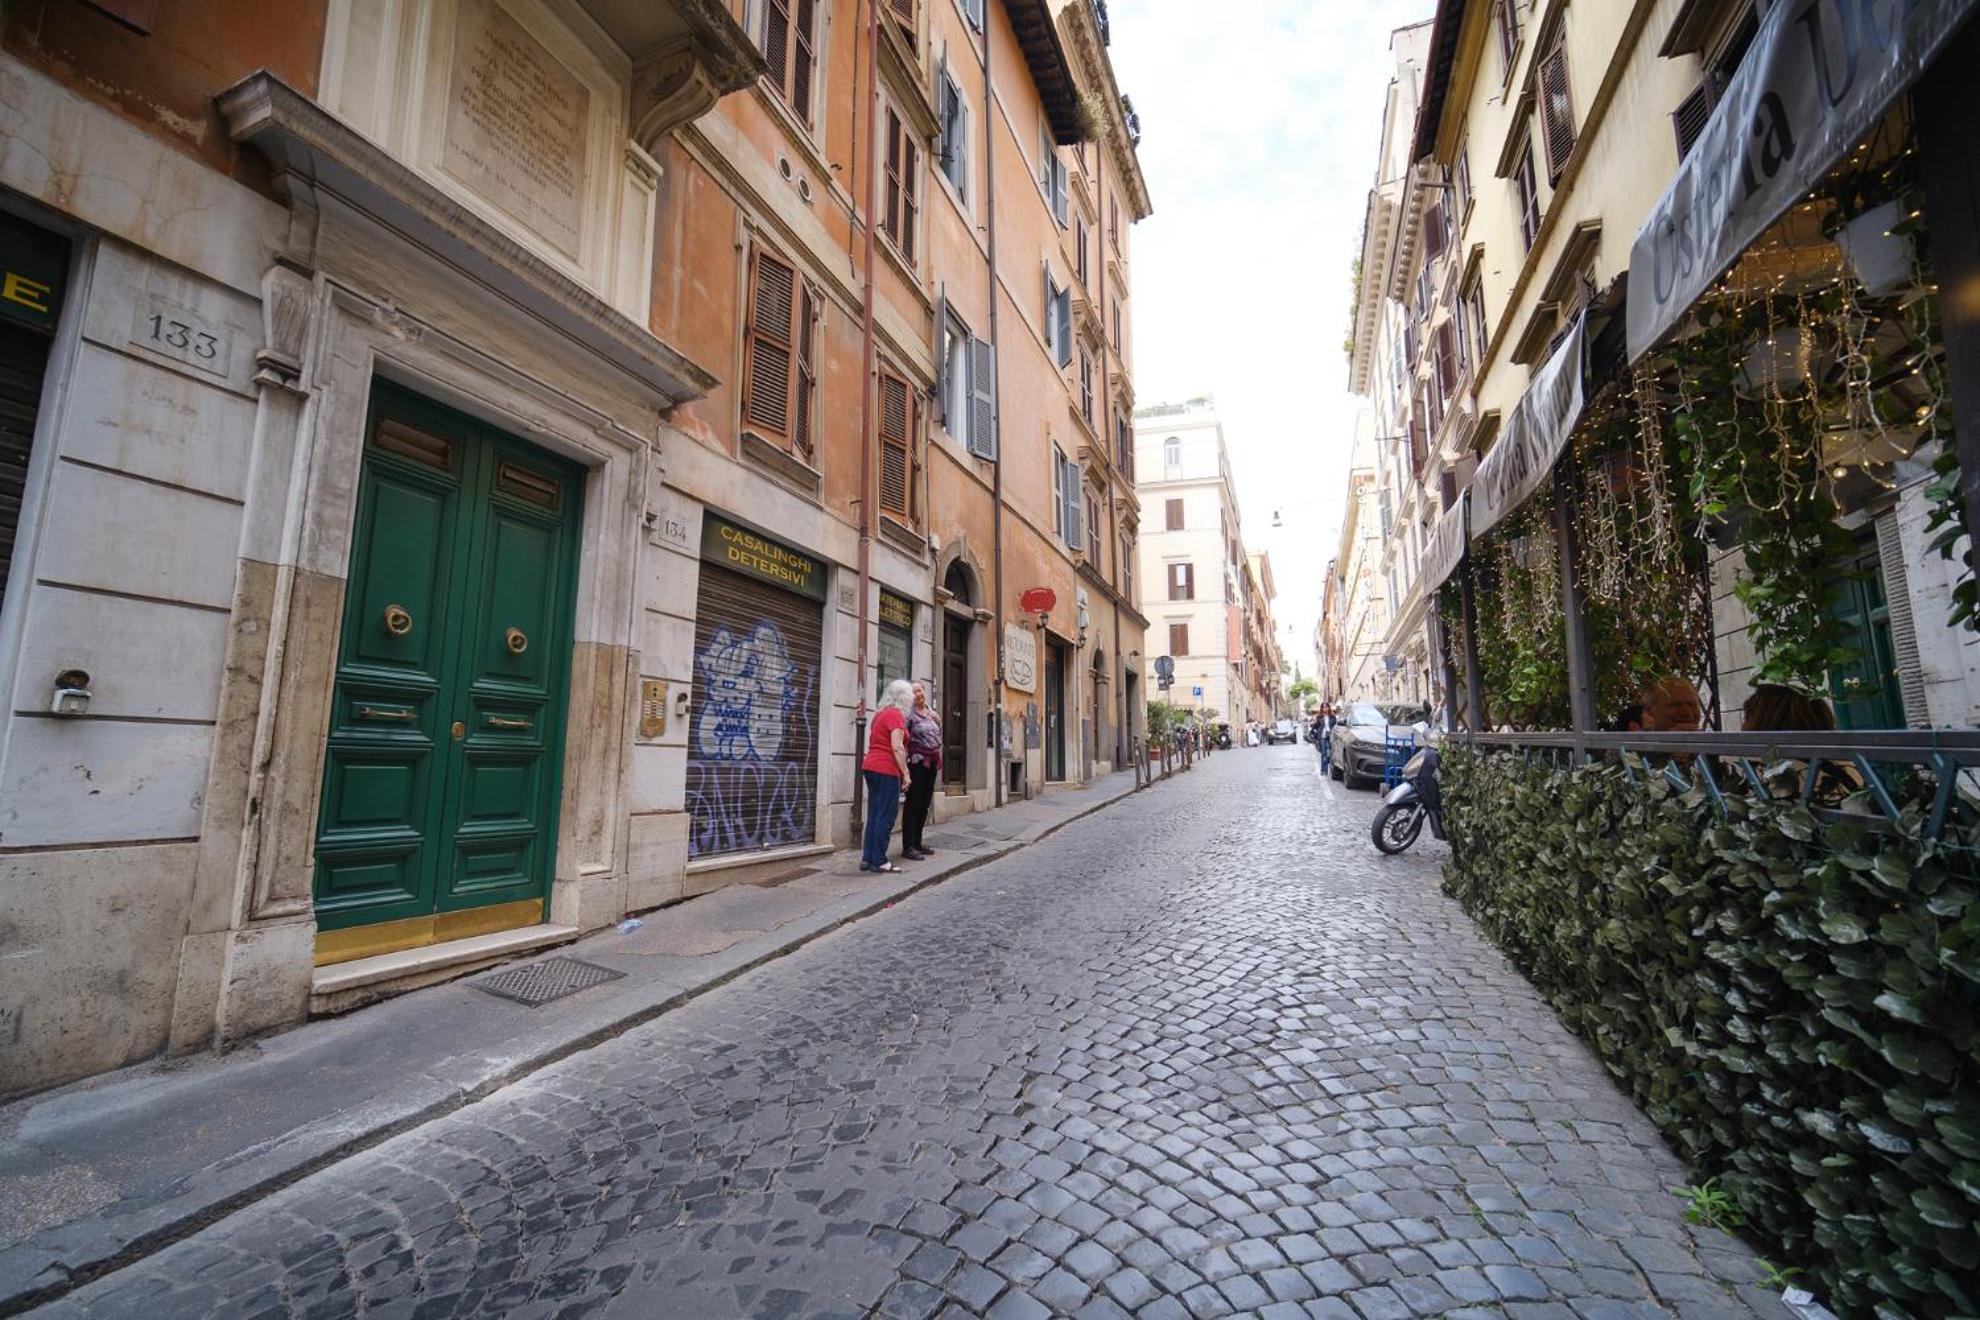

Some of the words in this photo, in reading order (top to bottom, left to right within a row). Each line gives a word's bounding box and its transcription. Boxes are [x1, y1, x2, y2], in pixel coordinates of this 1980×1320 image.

[149, 313, 219, 360] 133
[664, 519, 687, 543] 134
[719, 525, 812, 574] CASALINGHI
[727, 546, 805, 588] DETERSIVI
